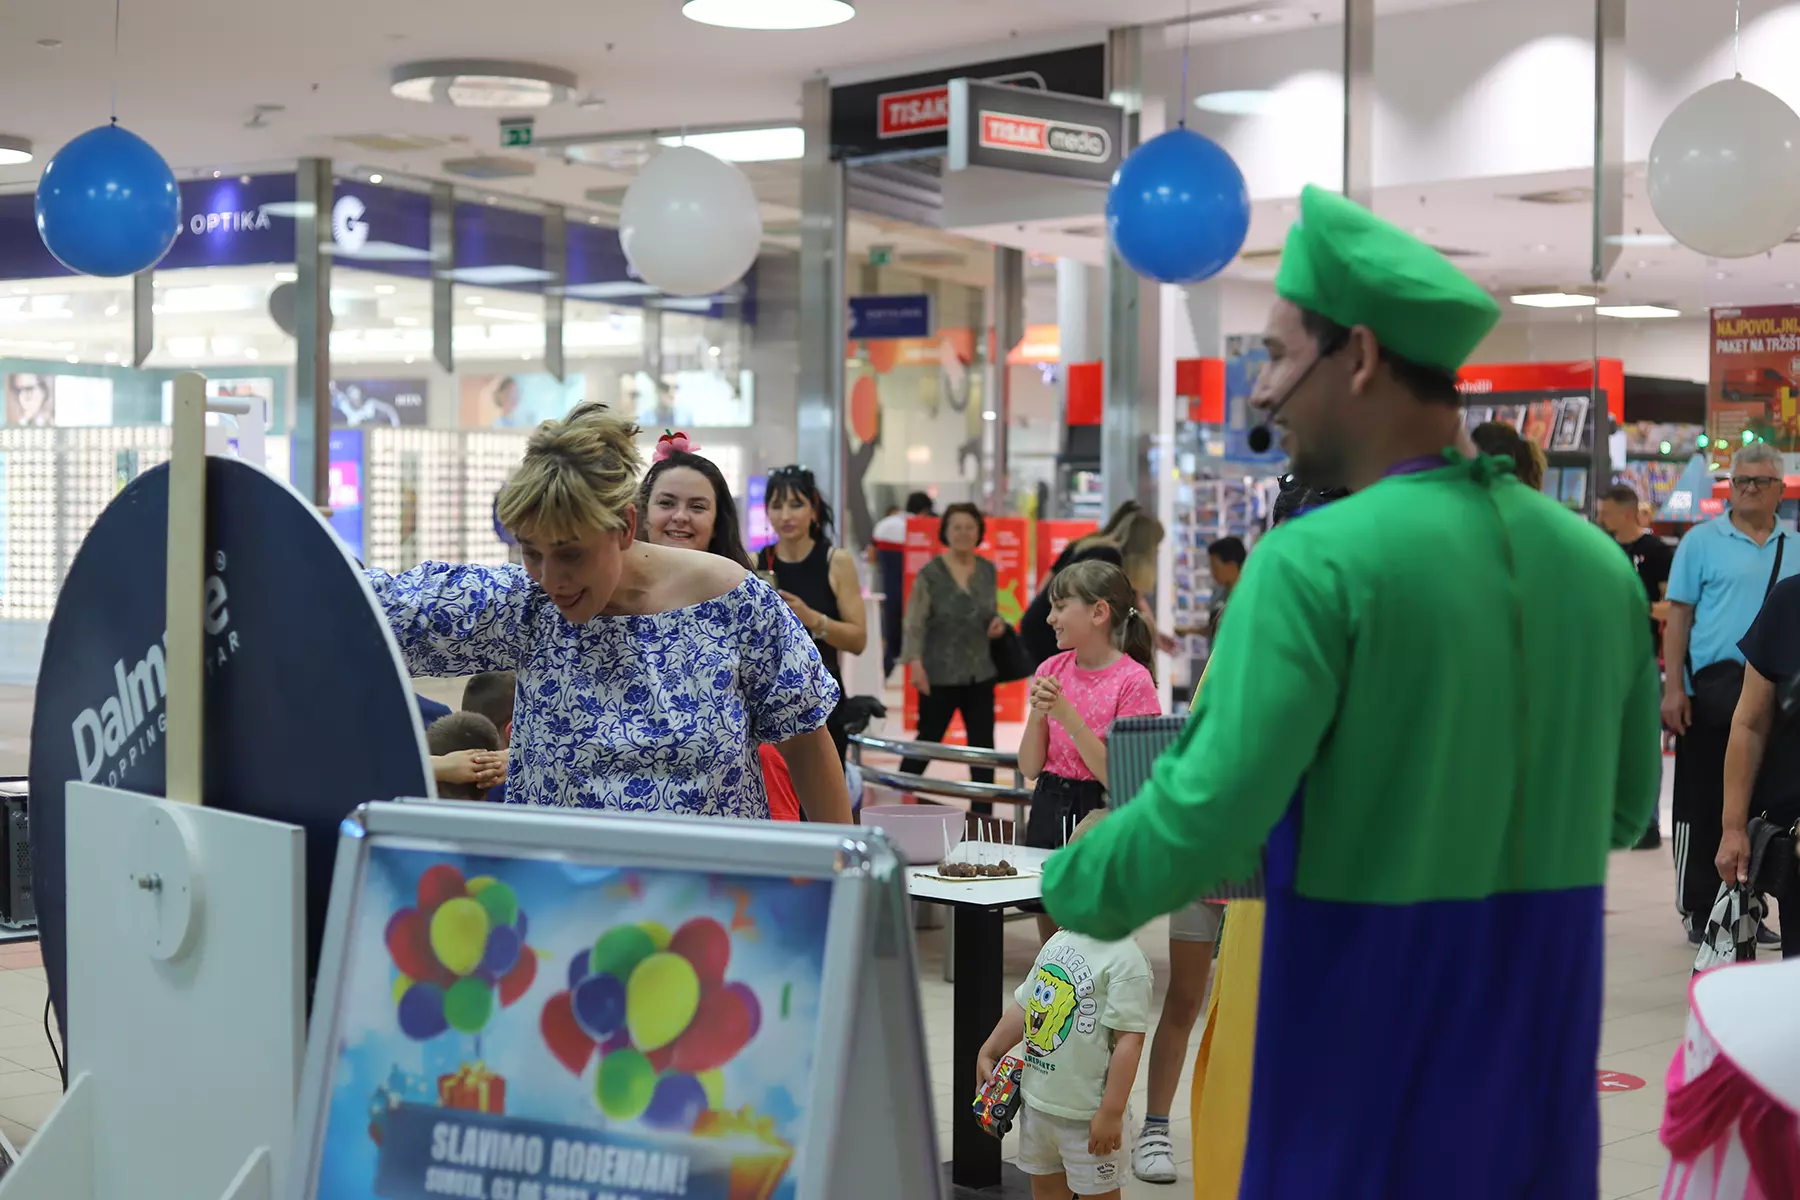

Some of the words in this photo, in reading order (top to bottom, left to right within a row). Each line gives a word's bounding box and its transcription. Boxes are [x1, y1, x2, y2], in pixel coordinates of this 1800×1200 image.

[989, 119, 1041, 145] TISAK
[190, 210, 272, 235] OPTIKA
[1715, 338, 1749, 354] PAKET
[1750, 337, 1765, 352] NA
[72, 575, 229, 783] Dalme
[101, 713, 167, 789] OPPING
[431, 1122, 543, 1174] SLAVIMO
